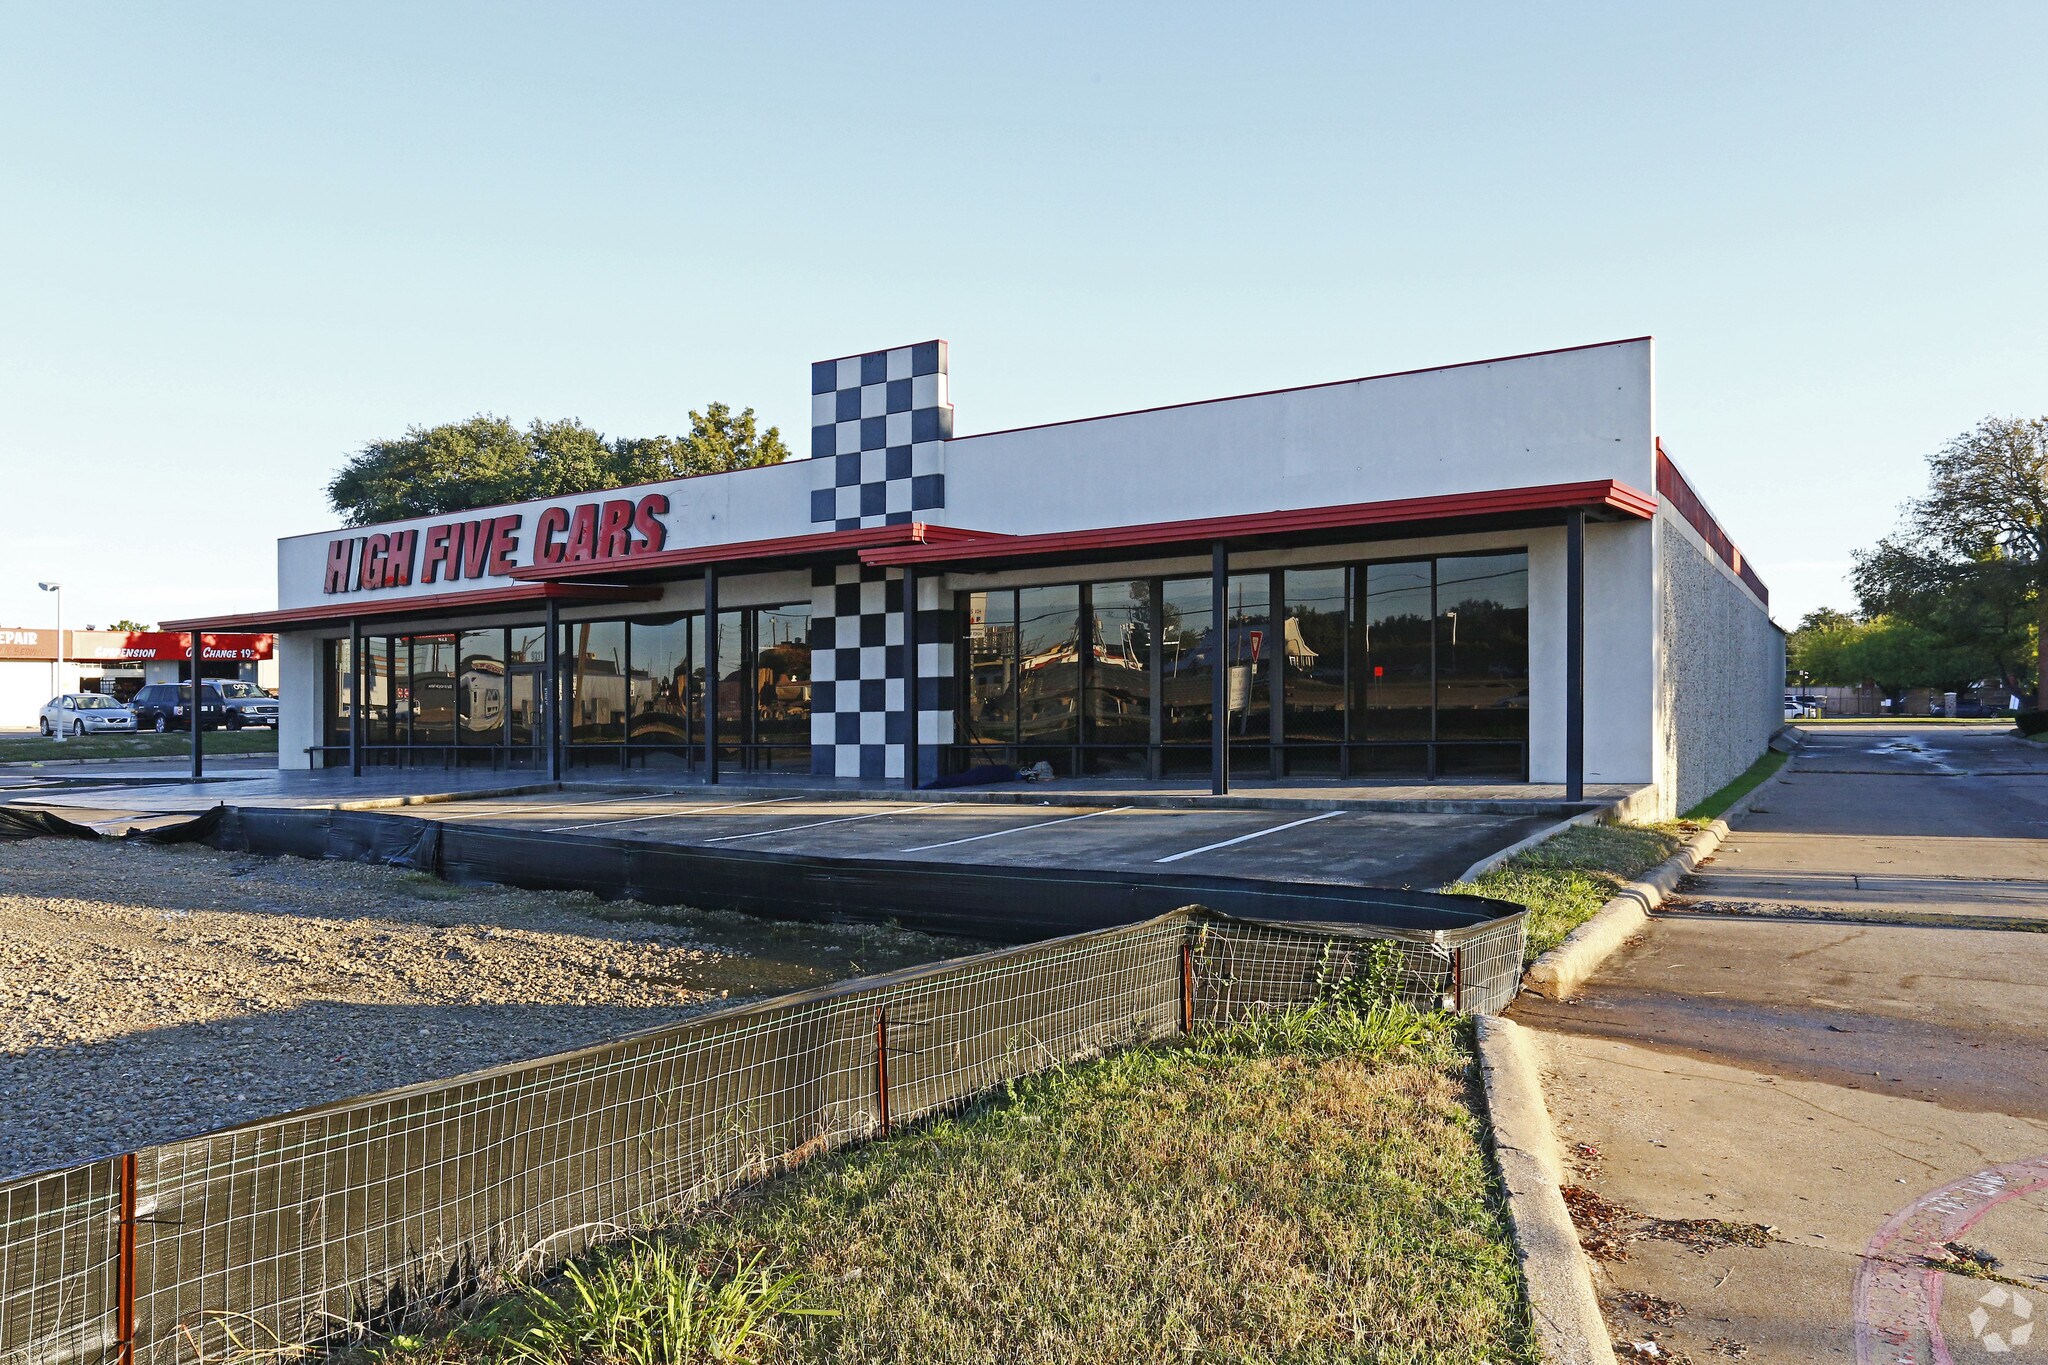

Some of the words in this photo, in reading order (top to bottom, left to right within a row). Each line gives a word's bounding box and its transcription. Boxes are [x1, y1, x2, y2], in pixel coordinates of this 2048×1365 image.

[324, 529, 418, 594] HIGH
[421, 515, 523, 583] FIVE
[533, 494, 670, 567] CARS
[94, 646, 156, 658] SUSPENSION
[202, 646, 238, 658] CHANGE
